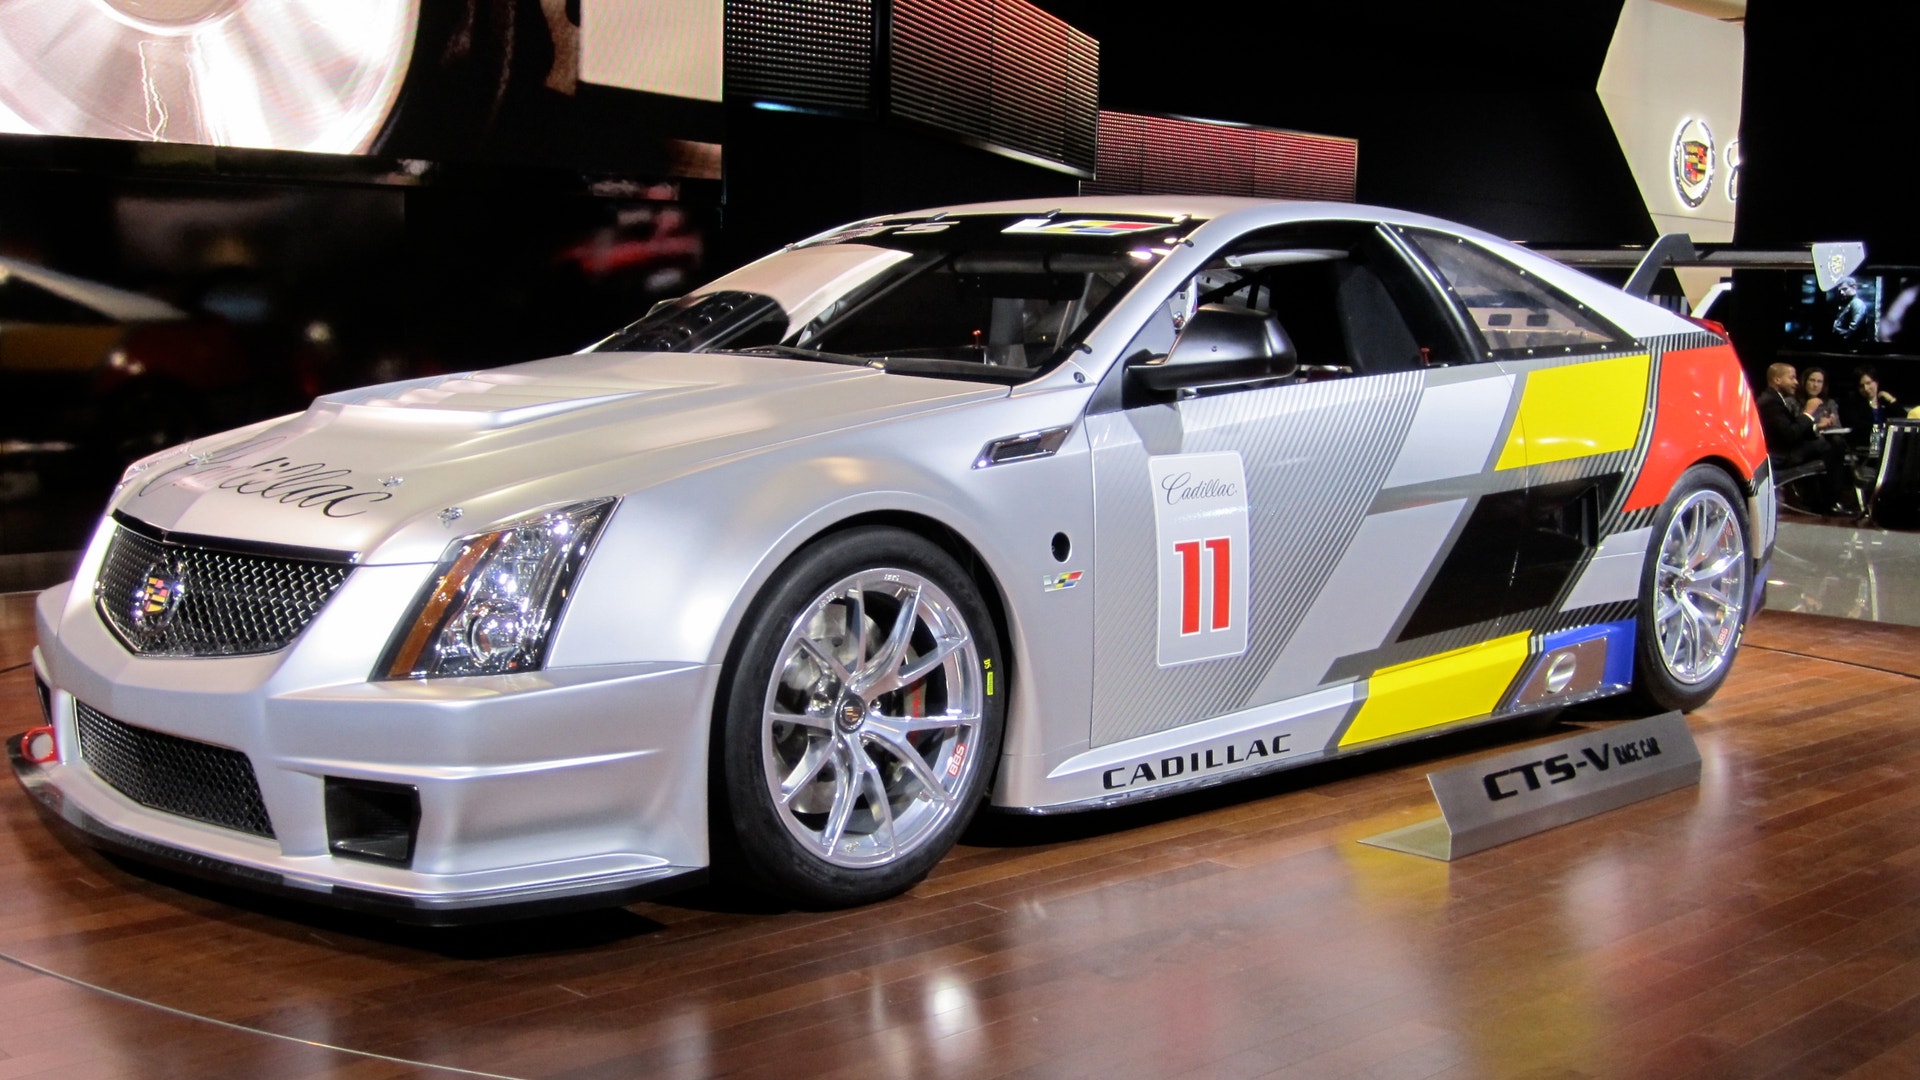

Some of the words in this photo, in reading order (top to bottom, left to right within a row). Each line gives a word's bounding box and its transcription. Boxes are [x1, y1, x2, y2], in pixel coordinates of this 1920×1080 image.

[1161, 472, 1237, 505] Cadillac
[1173, 536, 1231, 637] 11
[948, 744, 966, 776] BBS
[1103, 733, 1291, 790] CADILLAC
[1483, 743, 1609, 801] CTS-V
[1639, 737, 1661, 758] CAR
